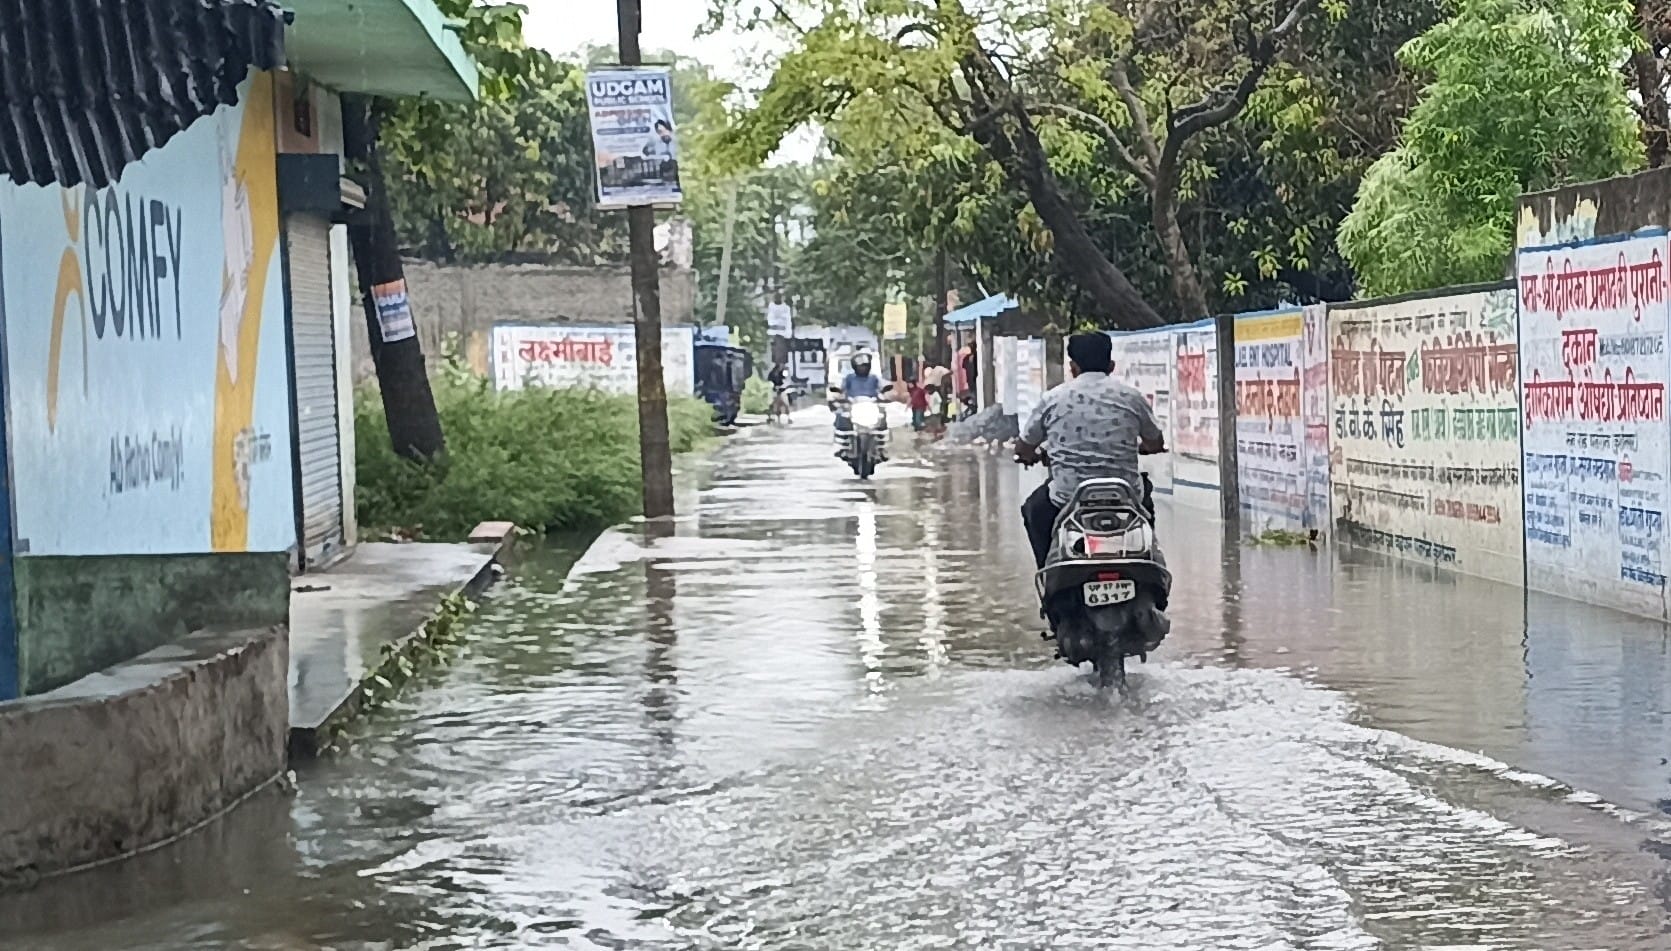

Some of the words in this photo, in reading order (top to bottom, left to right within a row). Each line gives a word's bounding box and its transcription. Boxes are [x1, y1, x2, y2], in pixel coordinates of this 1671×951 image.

[592, 80, 664, 96] UDGAM
[84, 184, 181, 340] COMFY
[519, 335, 613, 366] लक्ष्मीबाई
[1380, 398, 1405, 448] सिंह
